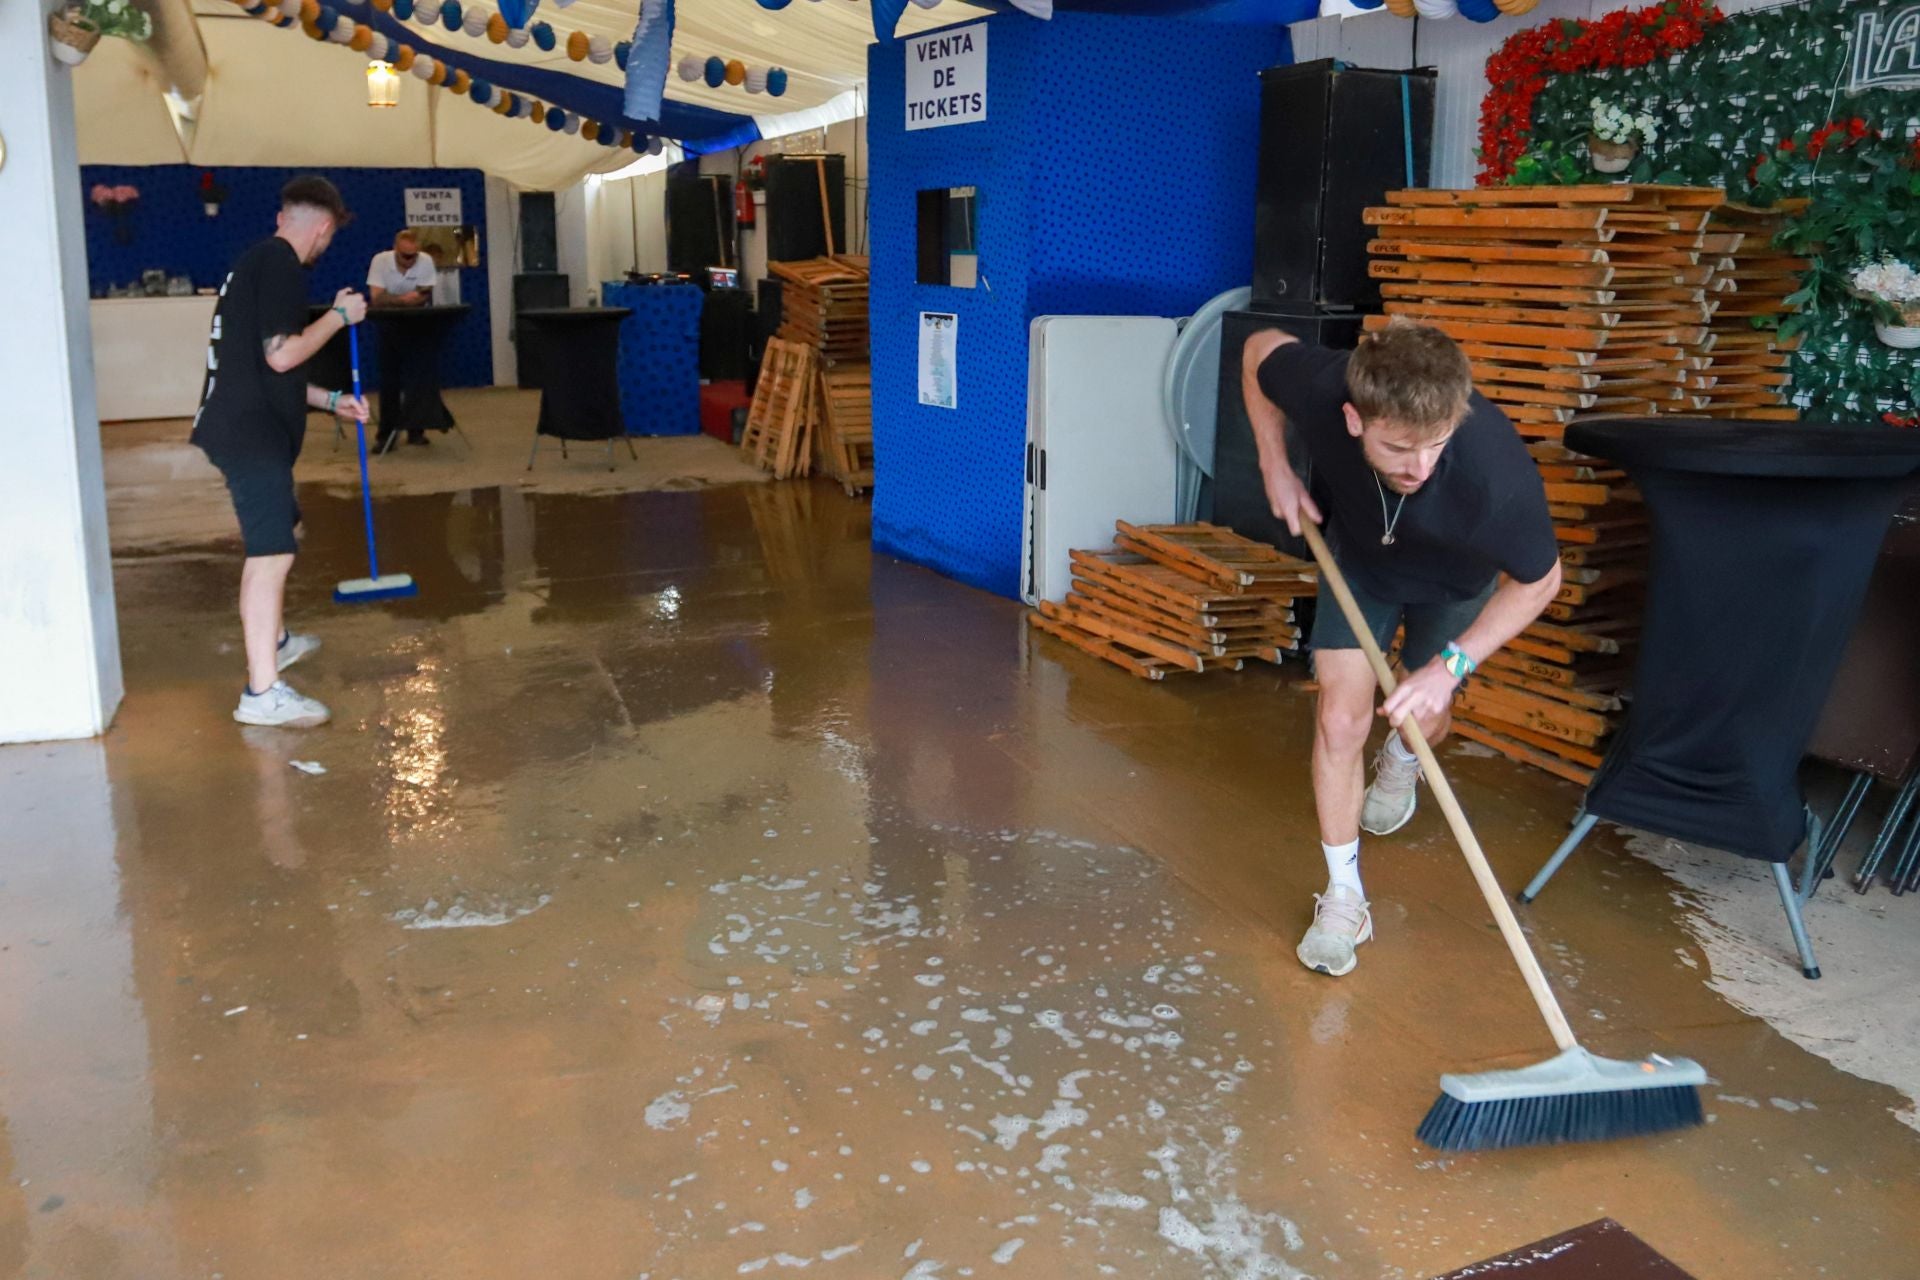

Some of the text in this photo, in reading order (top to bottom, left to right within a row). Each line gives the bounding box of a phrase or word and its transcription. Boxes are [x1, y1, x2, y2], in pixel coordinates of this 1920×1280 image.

[917, 33, 973, 62] VENTA
[934, 66, 955, 88] DE
[909, 92, 982, 121] TICKETS
[413, 191, 452, 199] VENTA
[425, 202, 441, 211] DE
[408, 214, 459, 222] TICKETS
